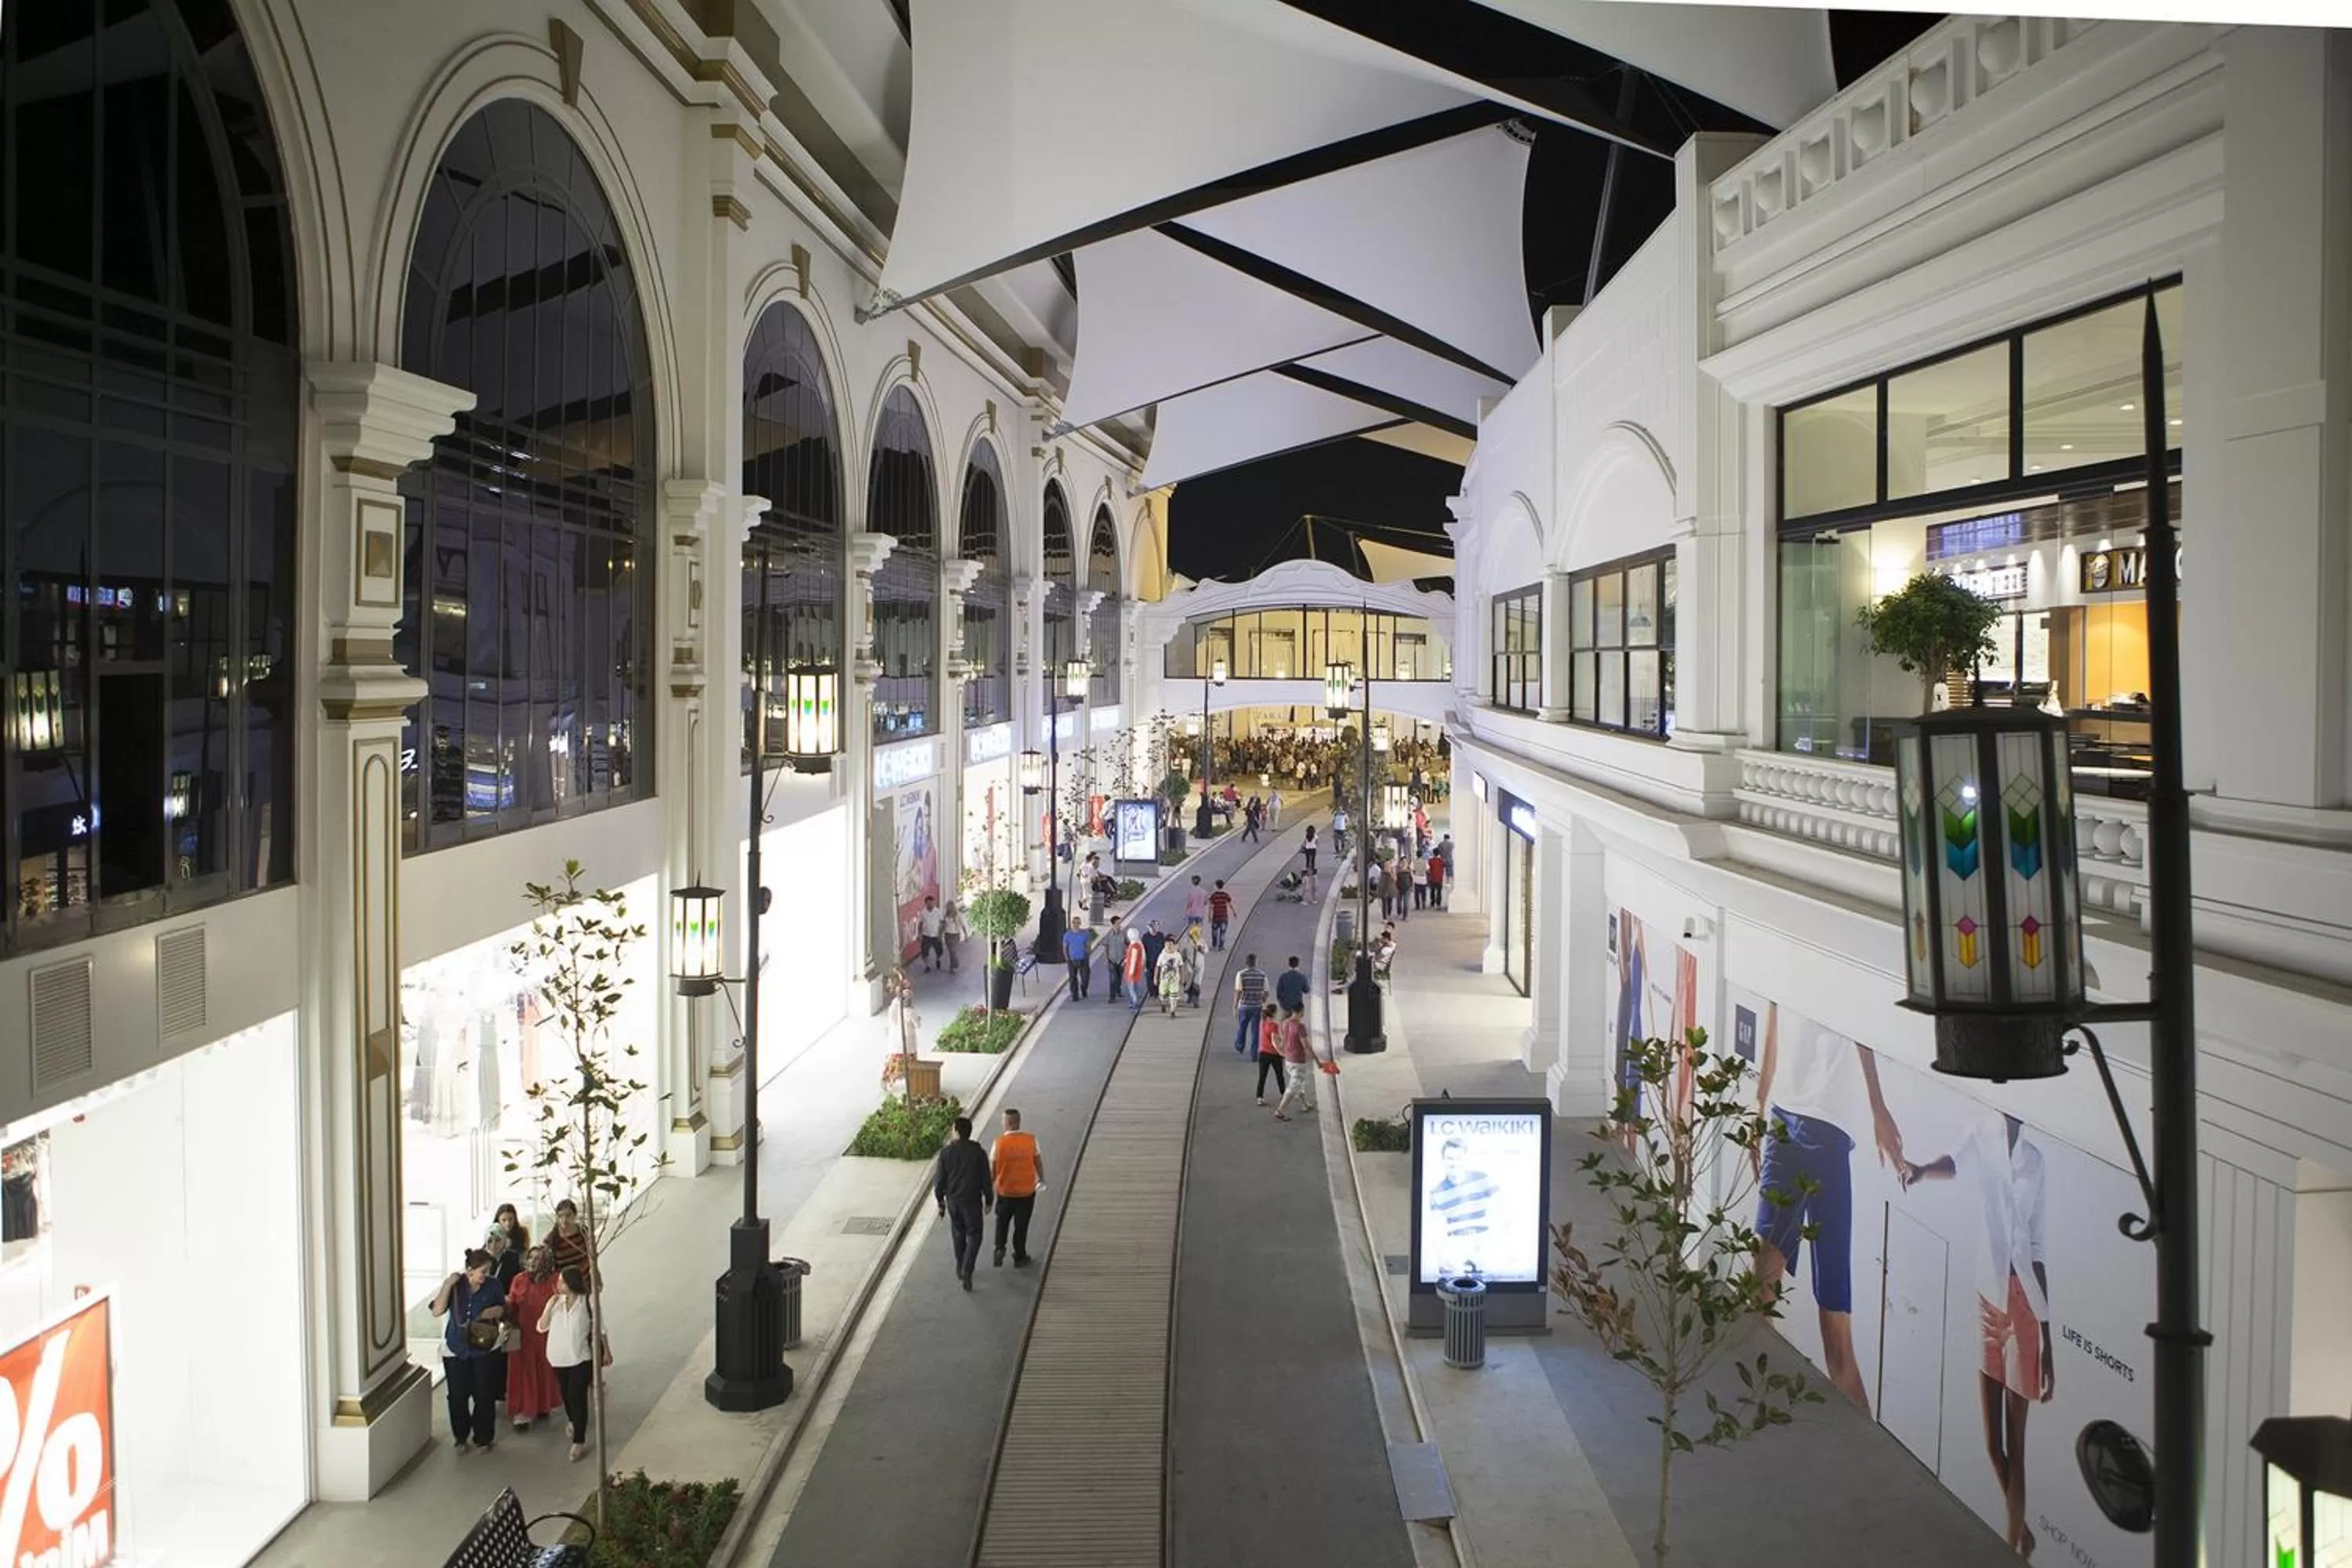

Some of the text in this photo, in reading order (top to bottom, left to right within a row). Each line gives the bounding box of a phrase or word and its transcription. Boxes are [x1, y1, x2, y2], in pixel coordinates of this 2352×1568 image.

[2063, 1323, 2134, 1382] LIFE IS SHORTS
